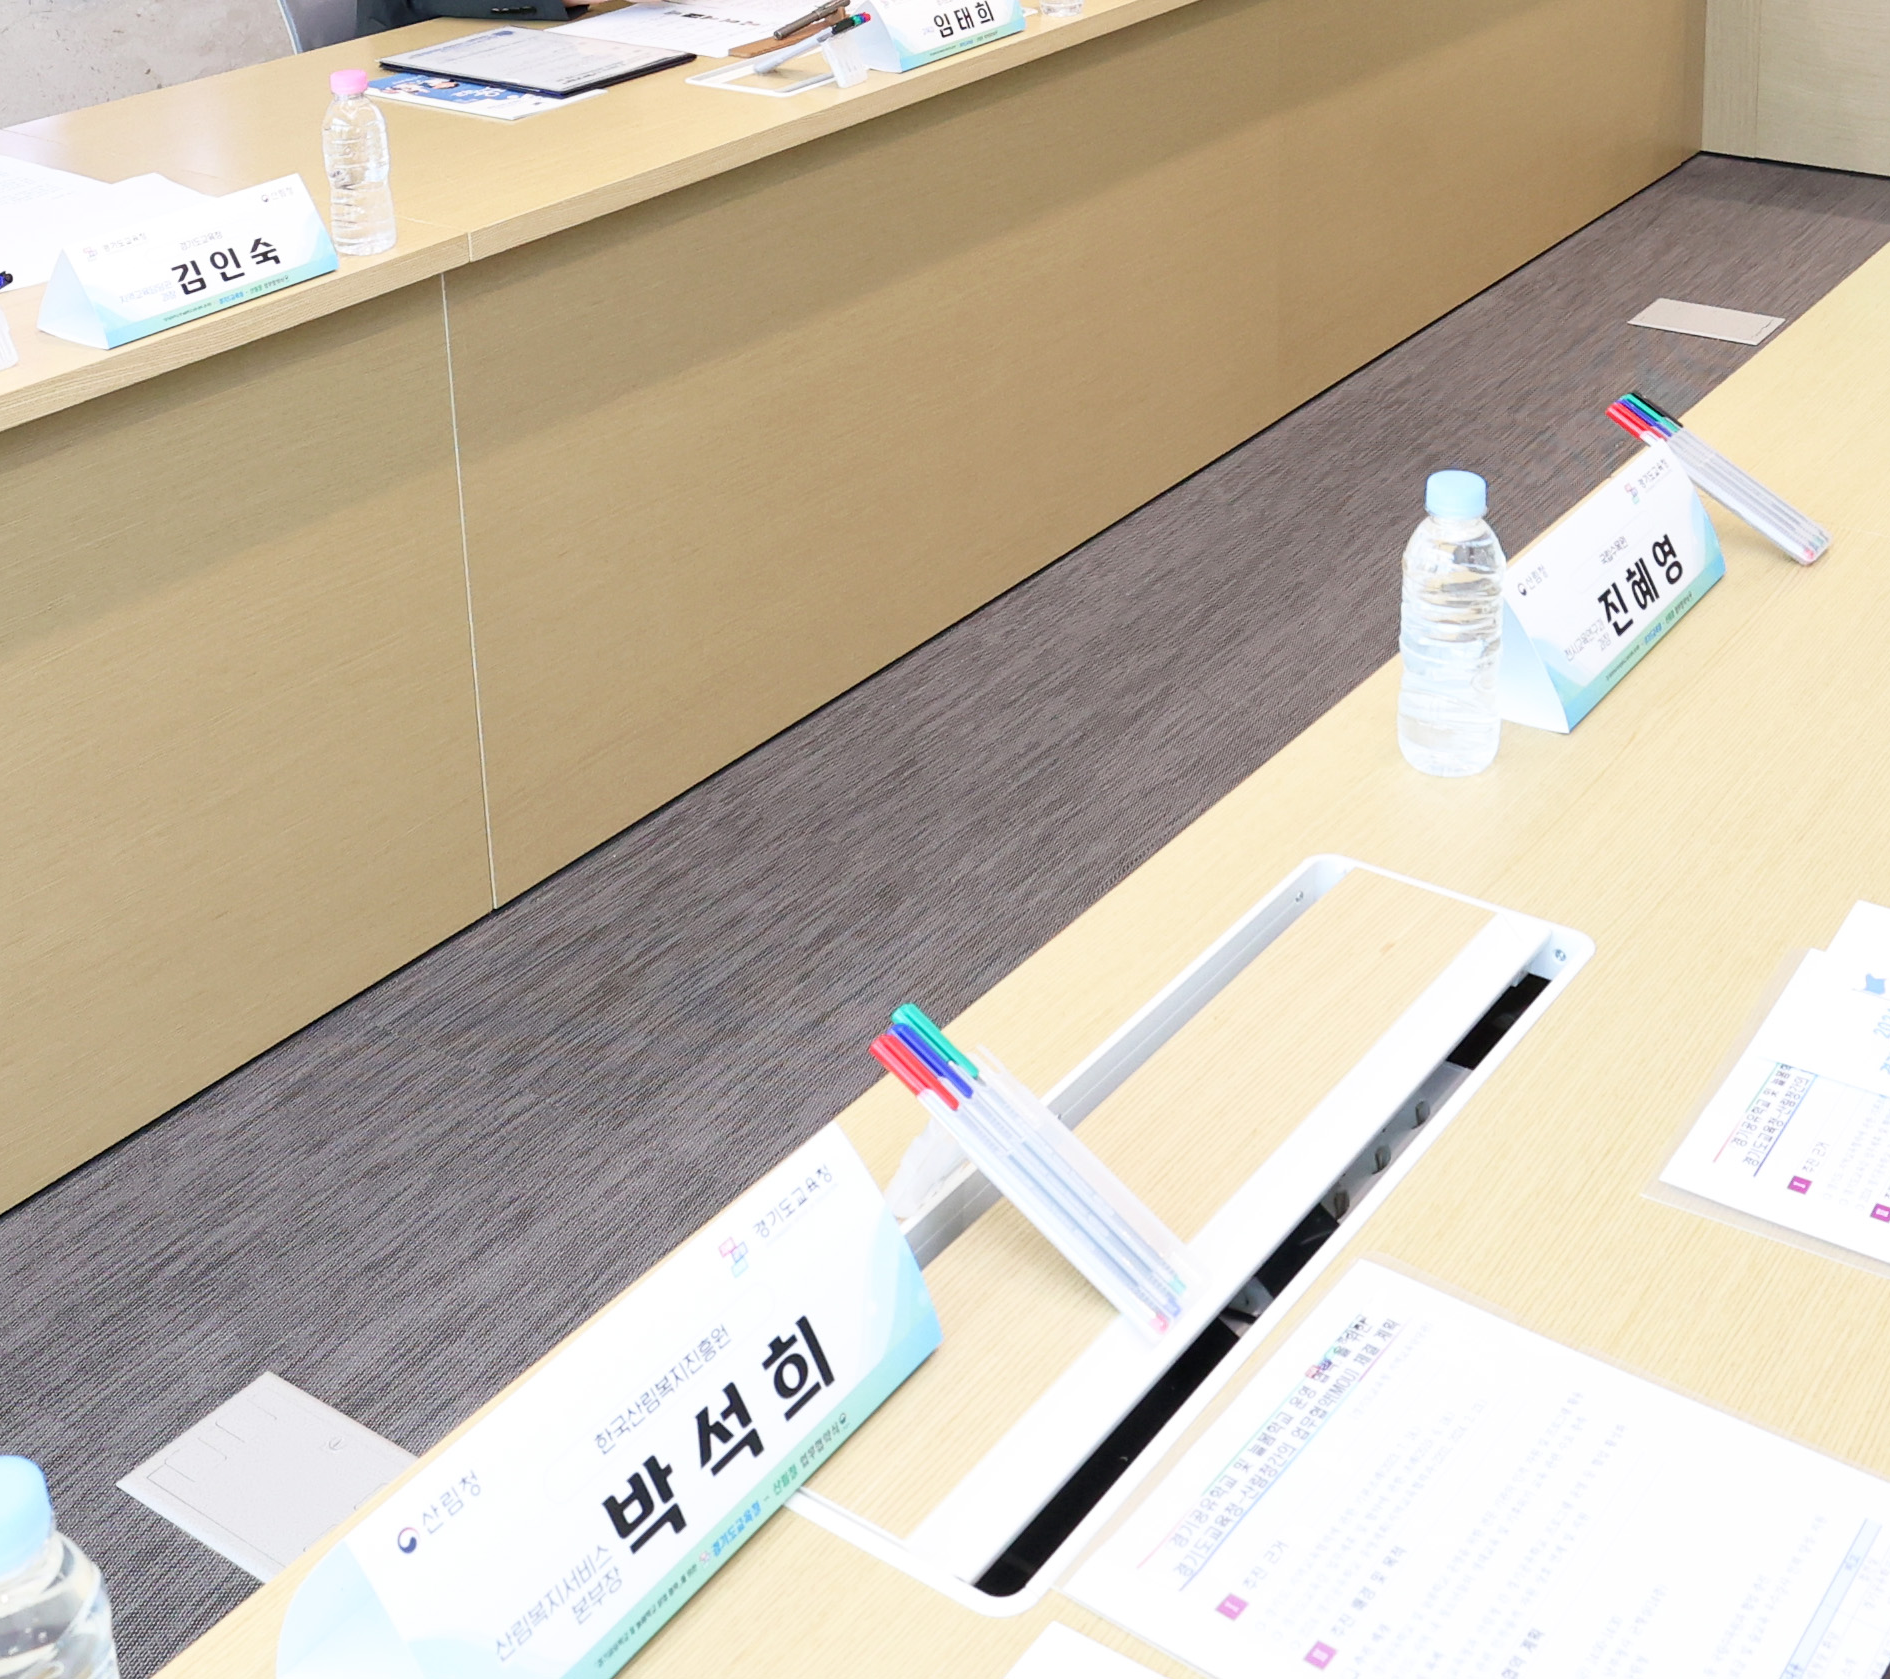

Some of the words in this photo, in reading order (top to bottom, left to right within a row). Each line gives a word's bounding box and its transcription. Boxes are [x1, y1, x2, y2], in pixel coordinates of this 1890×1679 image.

[753, 1162, 834, 1242] 경기도교육청
[593, 1322, 733, 1456] 한국산림복지진흥원
[420, 1467, 484, 1537] 산림청
[710, 1498, 763, 1558] 경기도교육청
[493, 1542, 612, 1663] 산림복지서비스
[569, 1564, 624, 1629] 본부장
